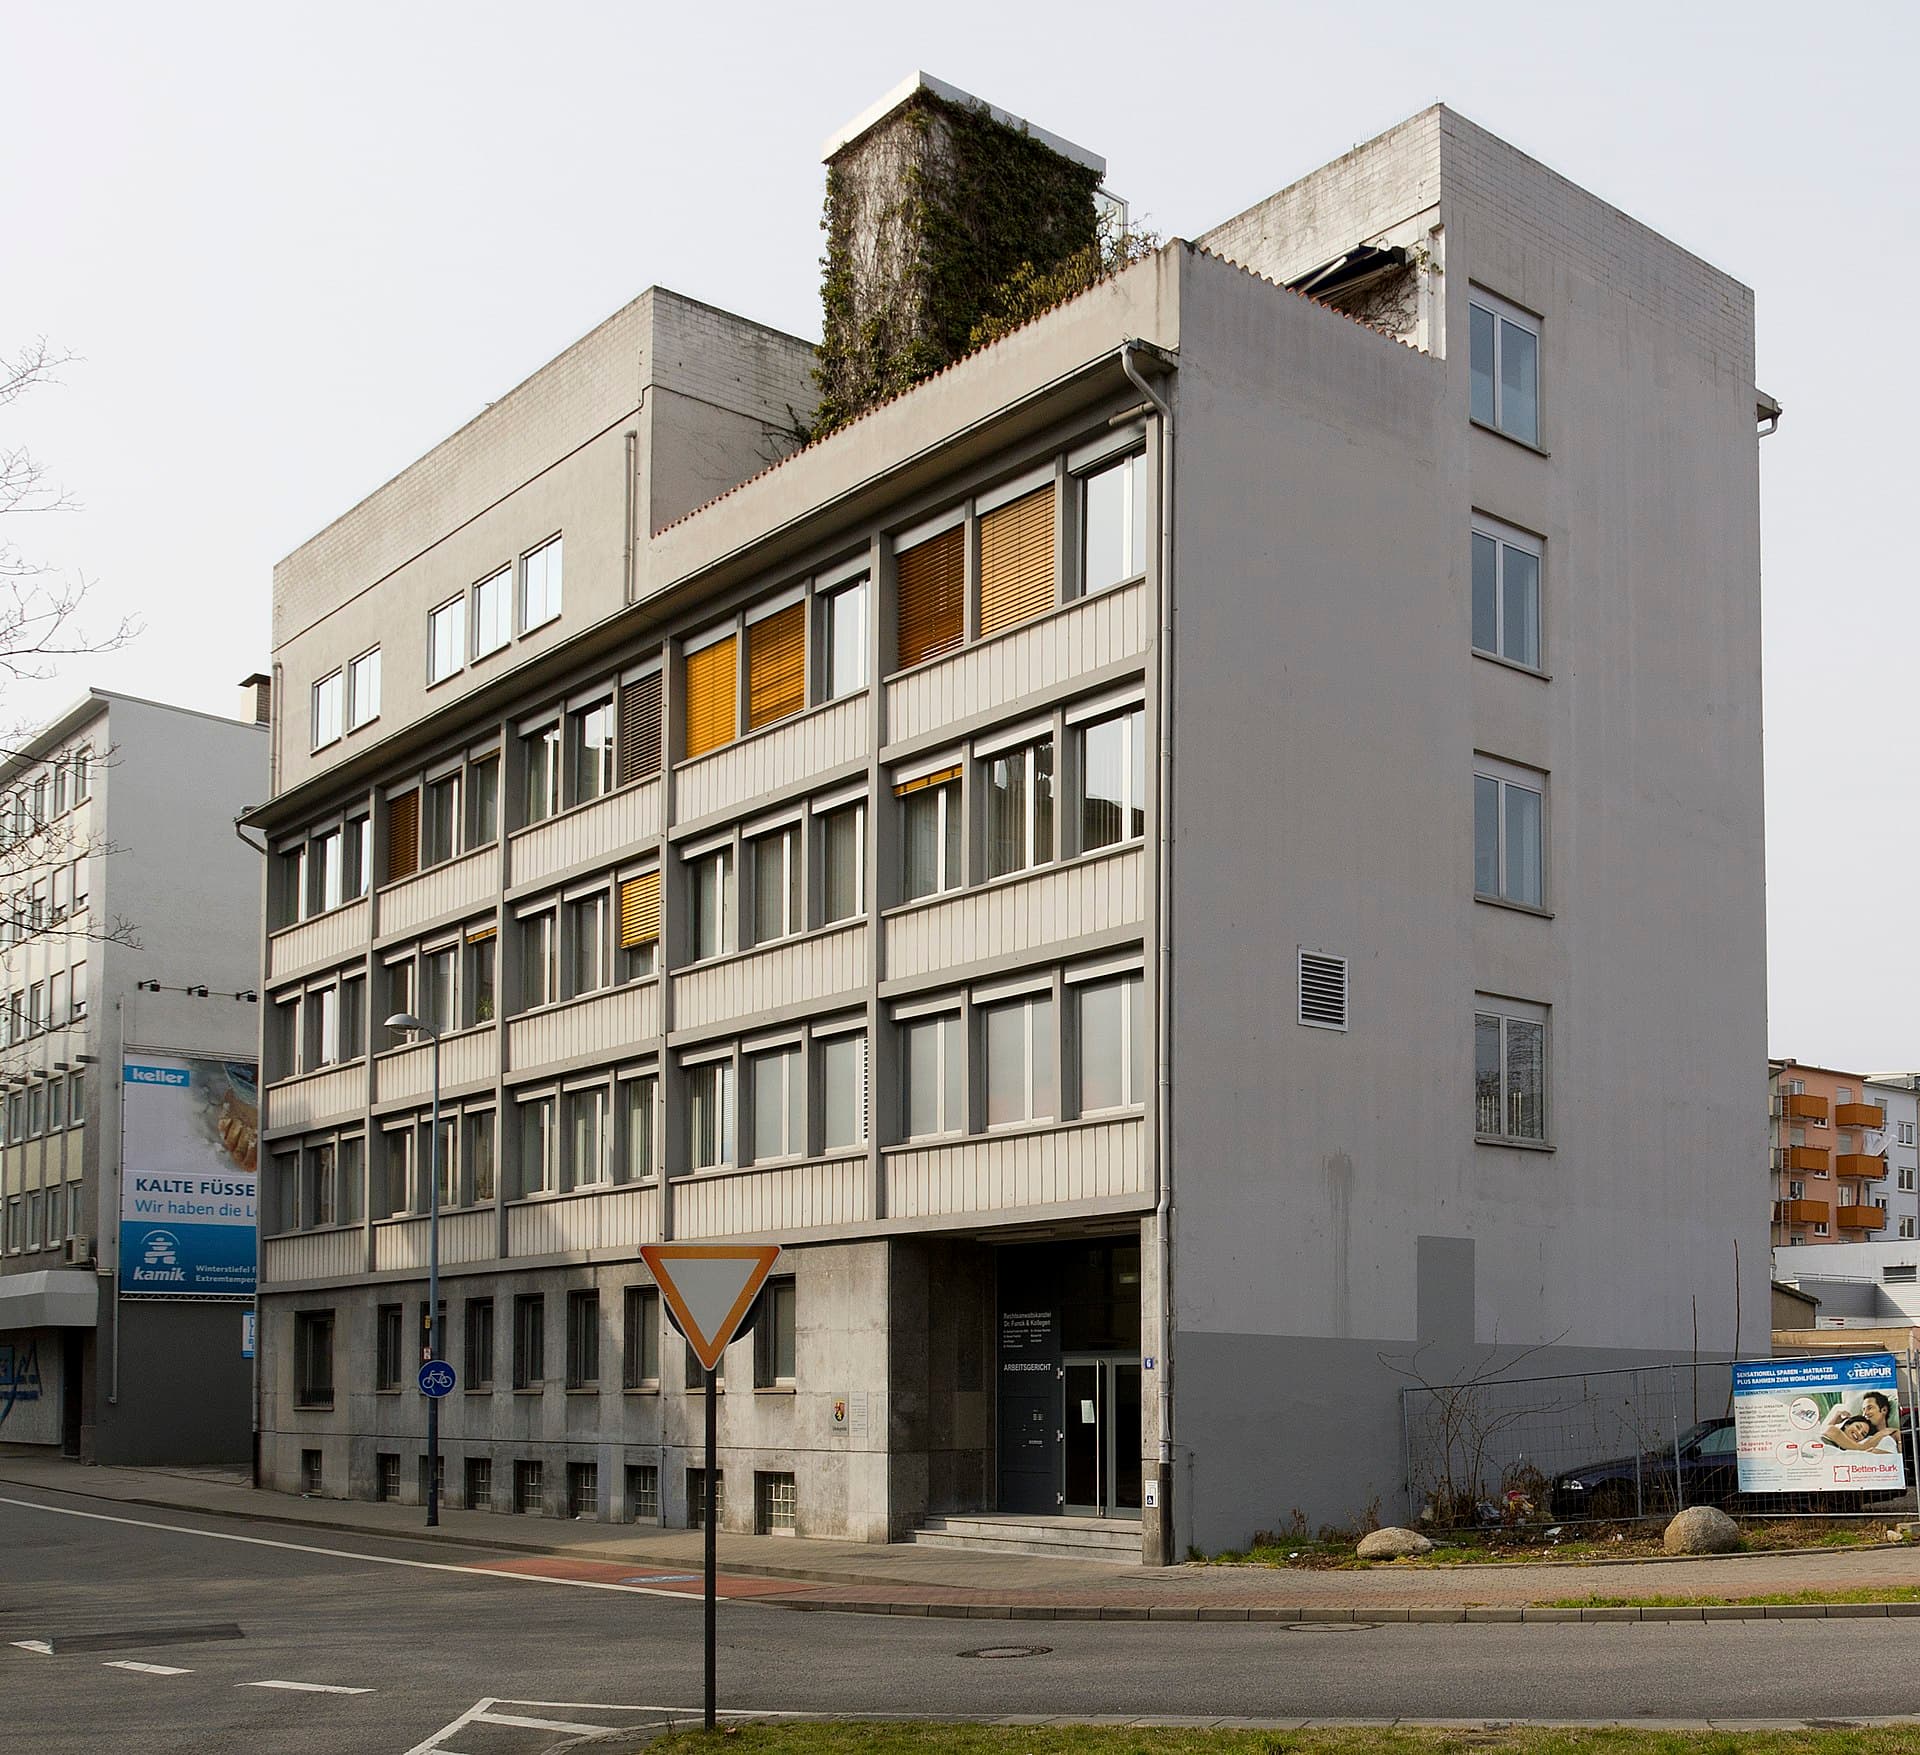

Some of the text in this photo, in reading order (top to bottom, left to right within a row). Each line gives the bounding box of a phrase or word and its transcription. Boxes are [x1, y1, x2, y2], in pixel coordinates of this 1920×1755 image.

[132, 1068, 185, 1084] keller
[136, 1178, 255, 1196] KALTE FÜSSE
[135, 1199, 164, 1214] Wir
[168, 1201, 214, 1216] haben
[219, 1203, 241, 1216] die
[133, 1266, 186, 1281] kamik
[195, 1265, 250, 1273] Winterstiefel
[195, 1275, 257, 1284] Extremtemper
[1003, 1363, 1051, 1371] ARBEITSGERICHT
[1736, 1370, 1776, 1378] SENSATIONELL
[1854, 1368, 1892, 1377] TEMPUR
[1789, 1373, 1839, 1382] WOHLFÜHLPREIS!
[1851, 1464, 1898, 1472] Betten-Burk
